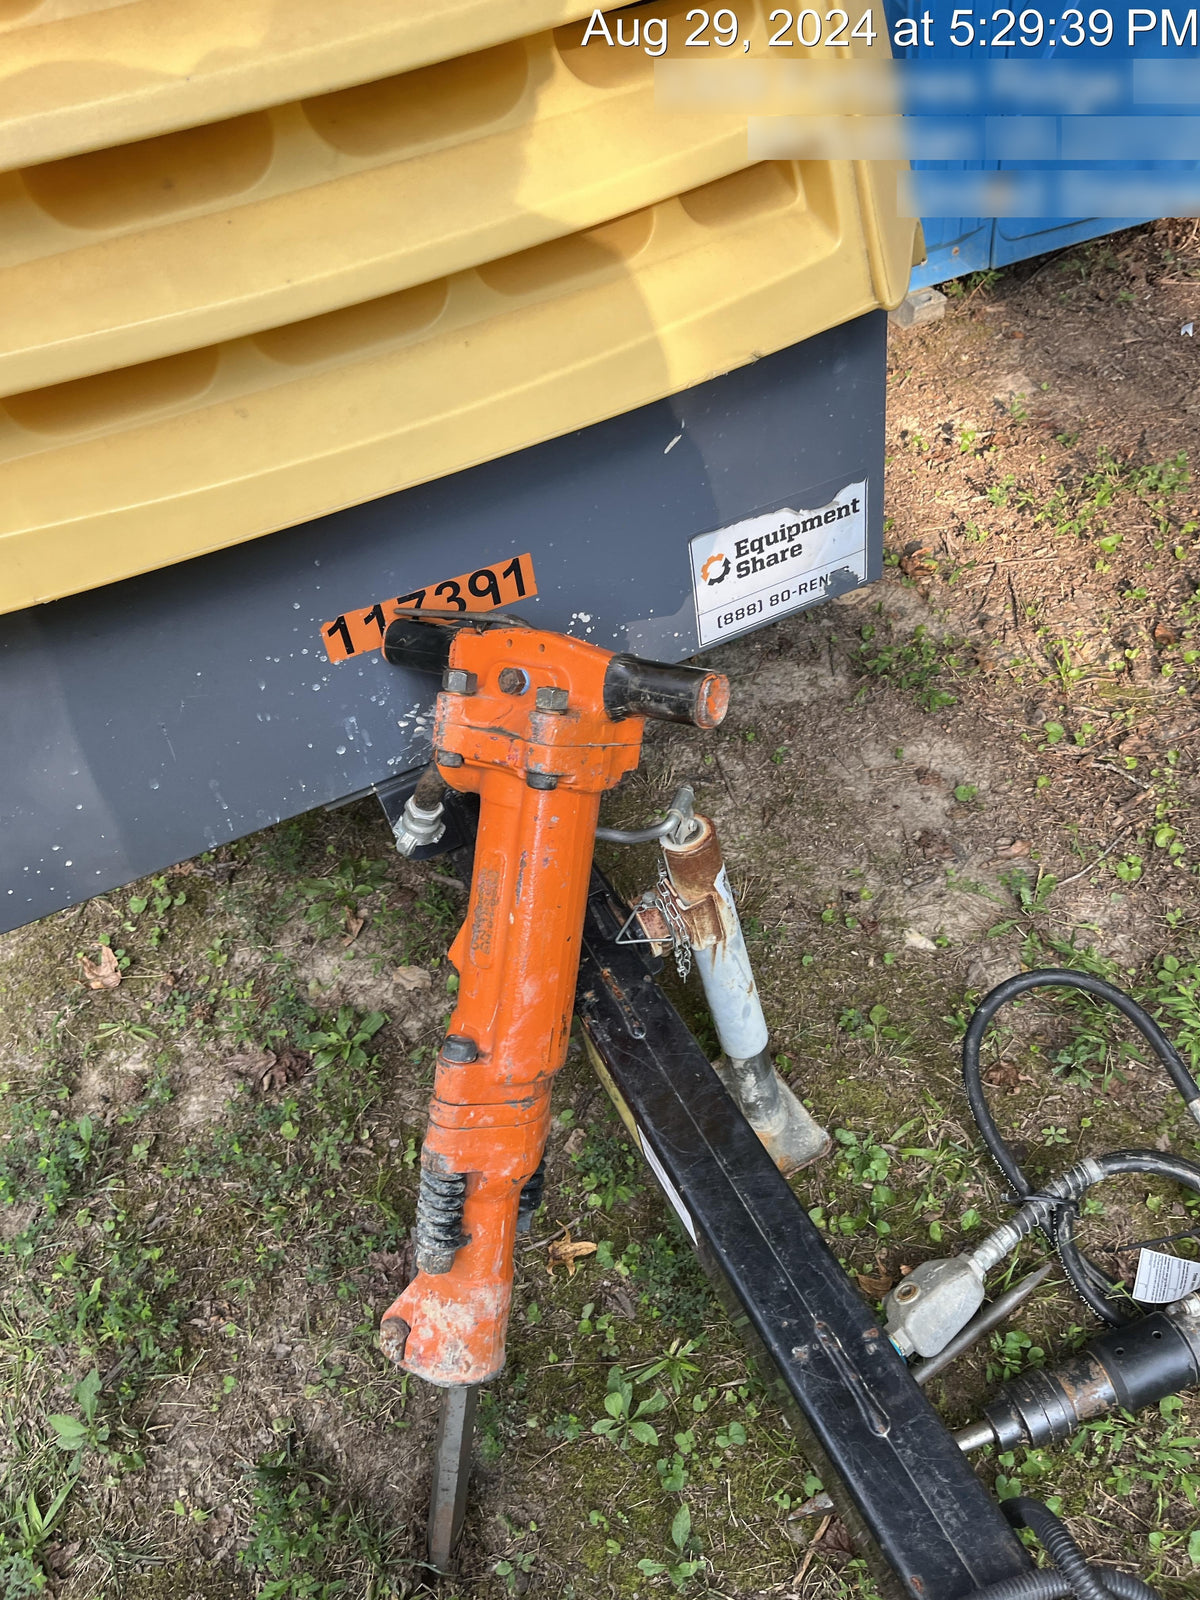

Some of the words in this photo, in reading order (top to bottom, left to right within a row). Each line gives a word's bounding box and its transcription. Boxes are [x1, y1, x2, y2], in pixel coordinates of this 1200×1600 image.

[734, 498, 861, 559] Equipment
[736, 543, 803, 580] Share
[717, 599, 763, 629] (888)
[769, 565, 850, 607] 80-REN
